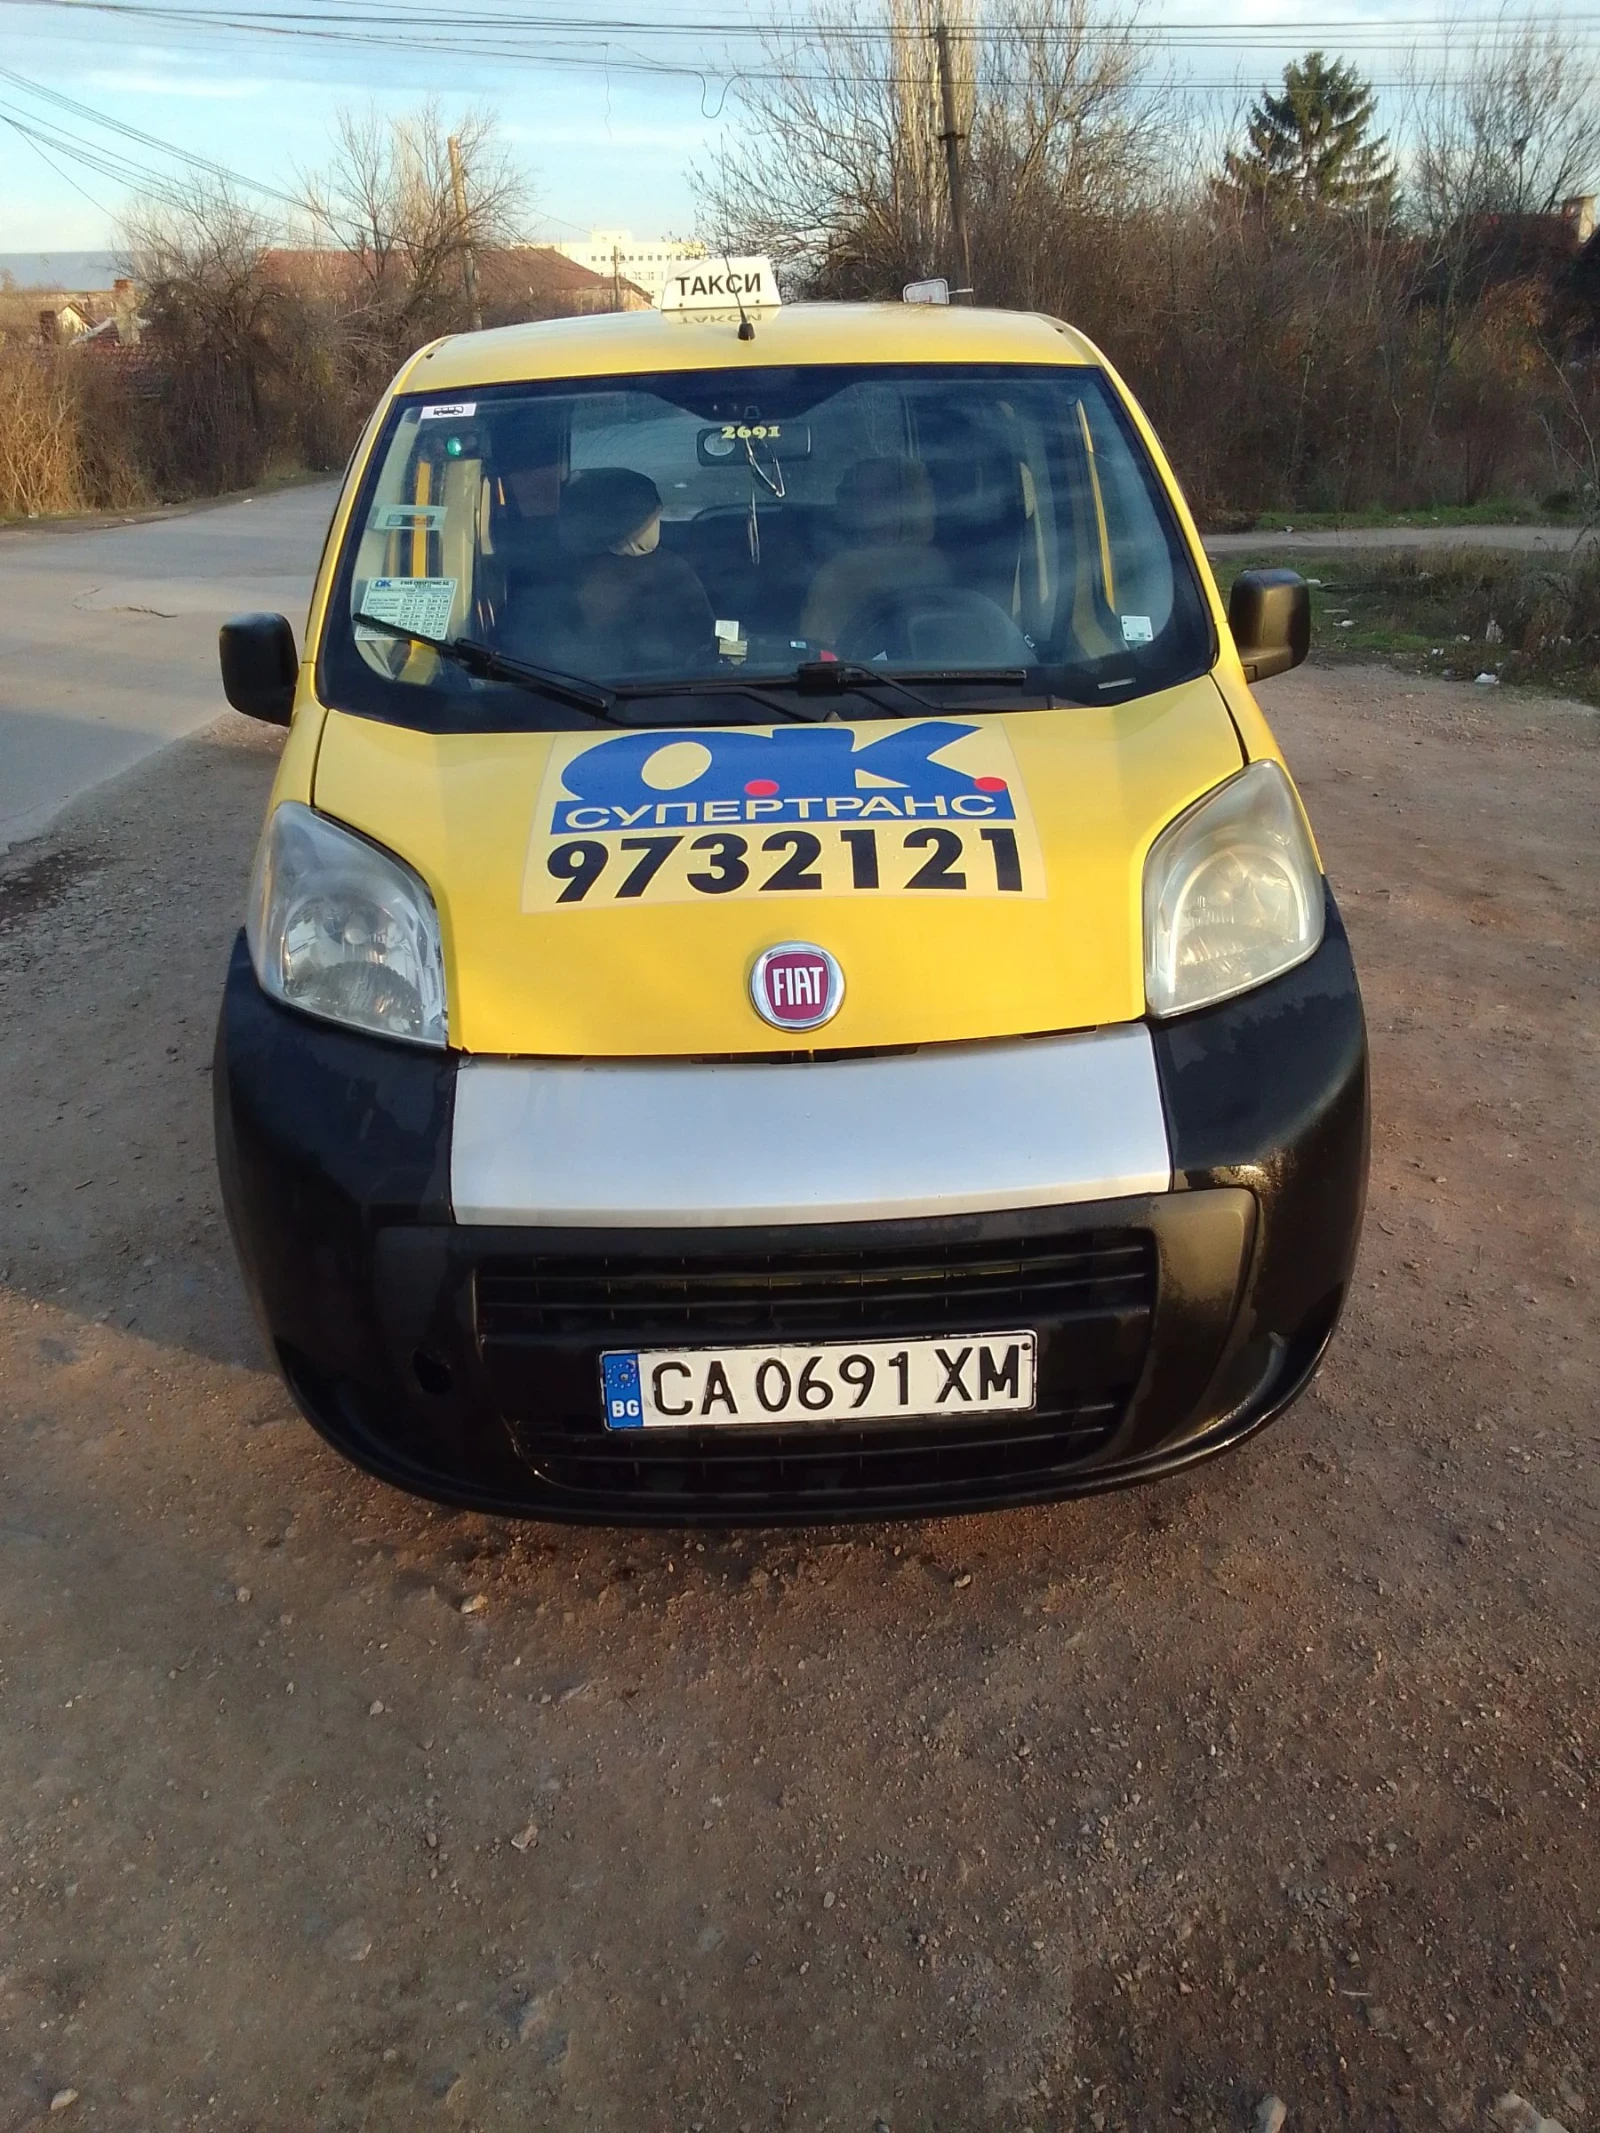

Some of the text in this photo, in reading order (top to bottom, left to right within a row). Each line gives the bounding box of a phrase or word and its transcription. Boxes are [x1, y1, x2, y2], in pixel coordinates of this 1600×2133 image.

[675, 272, 762, 296] ТАКСИ
[721, 426, 781, 439] 2691
[564, 795, 998, 829] СУПЕРТРАНС
[546, 827, 1024, 904] 9732121
[772, 966, 824, 1007] FIAT
[755, 1351, 911, 1413] 0691
[611, 1401, 640, 1419] BG
